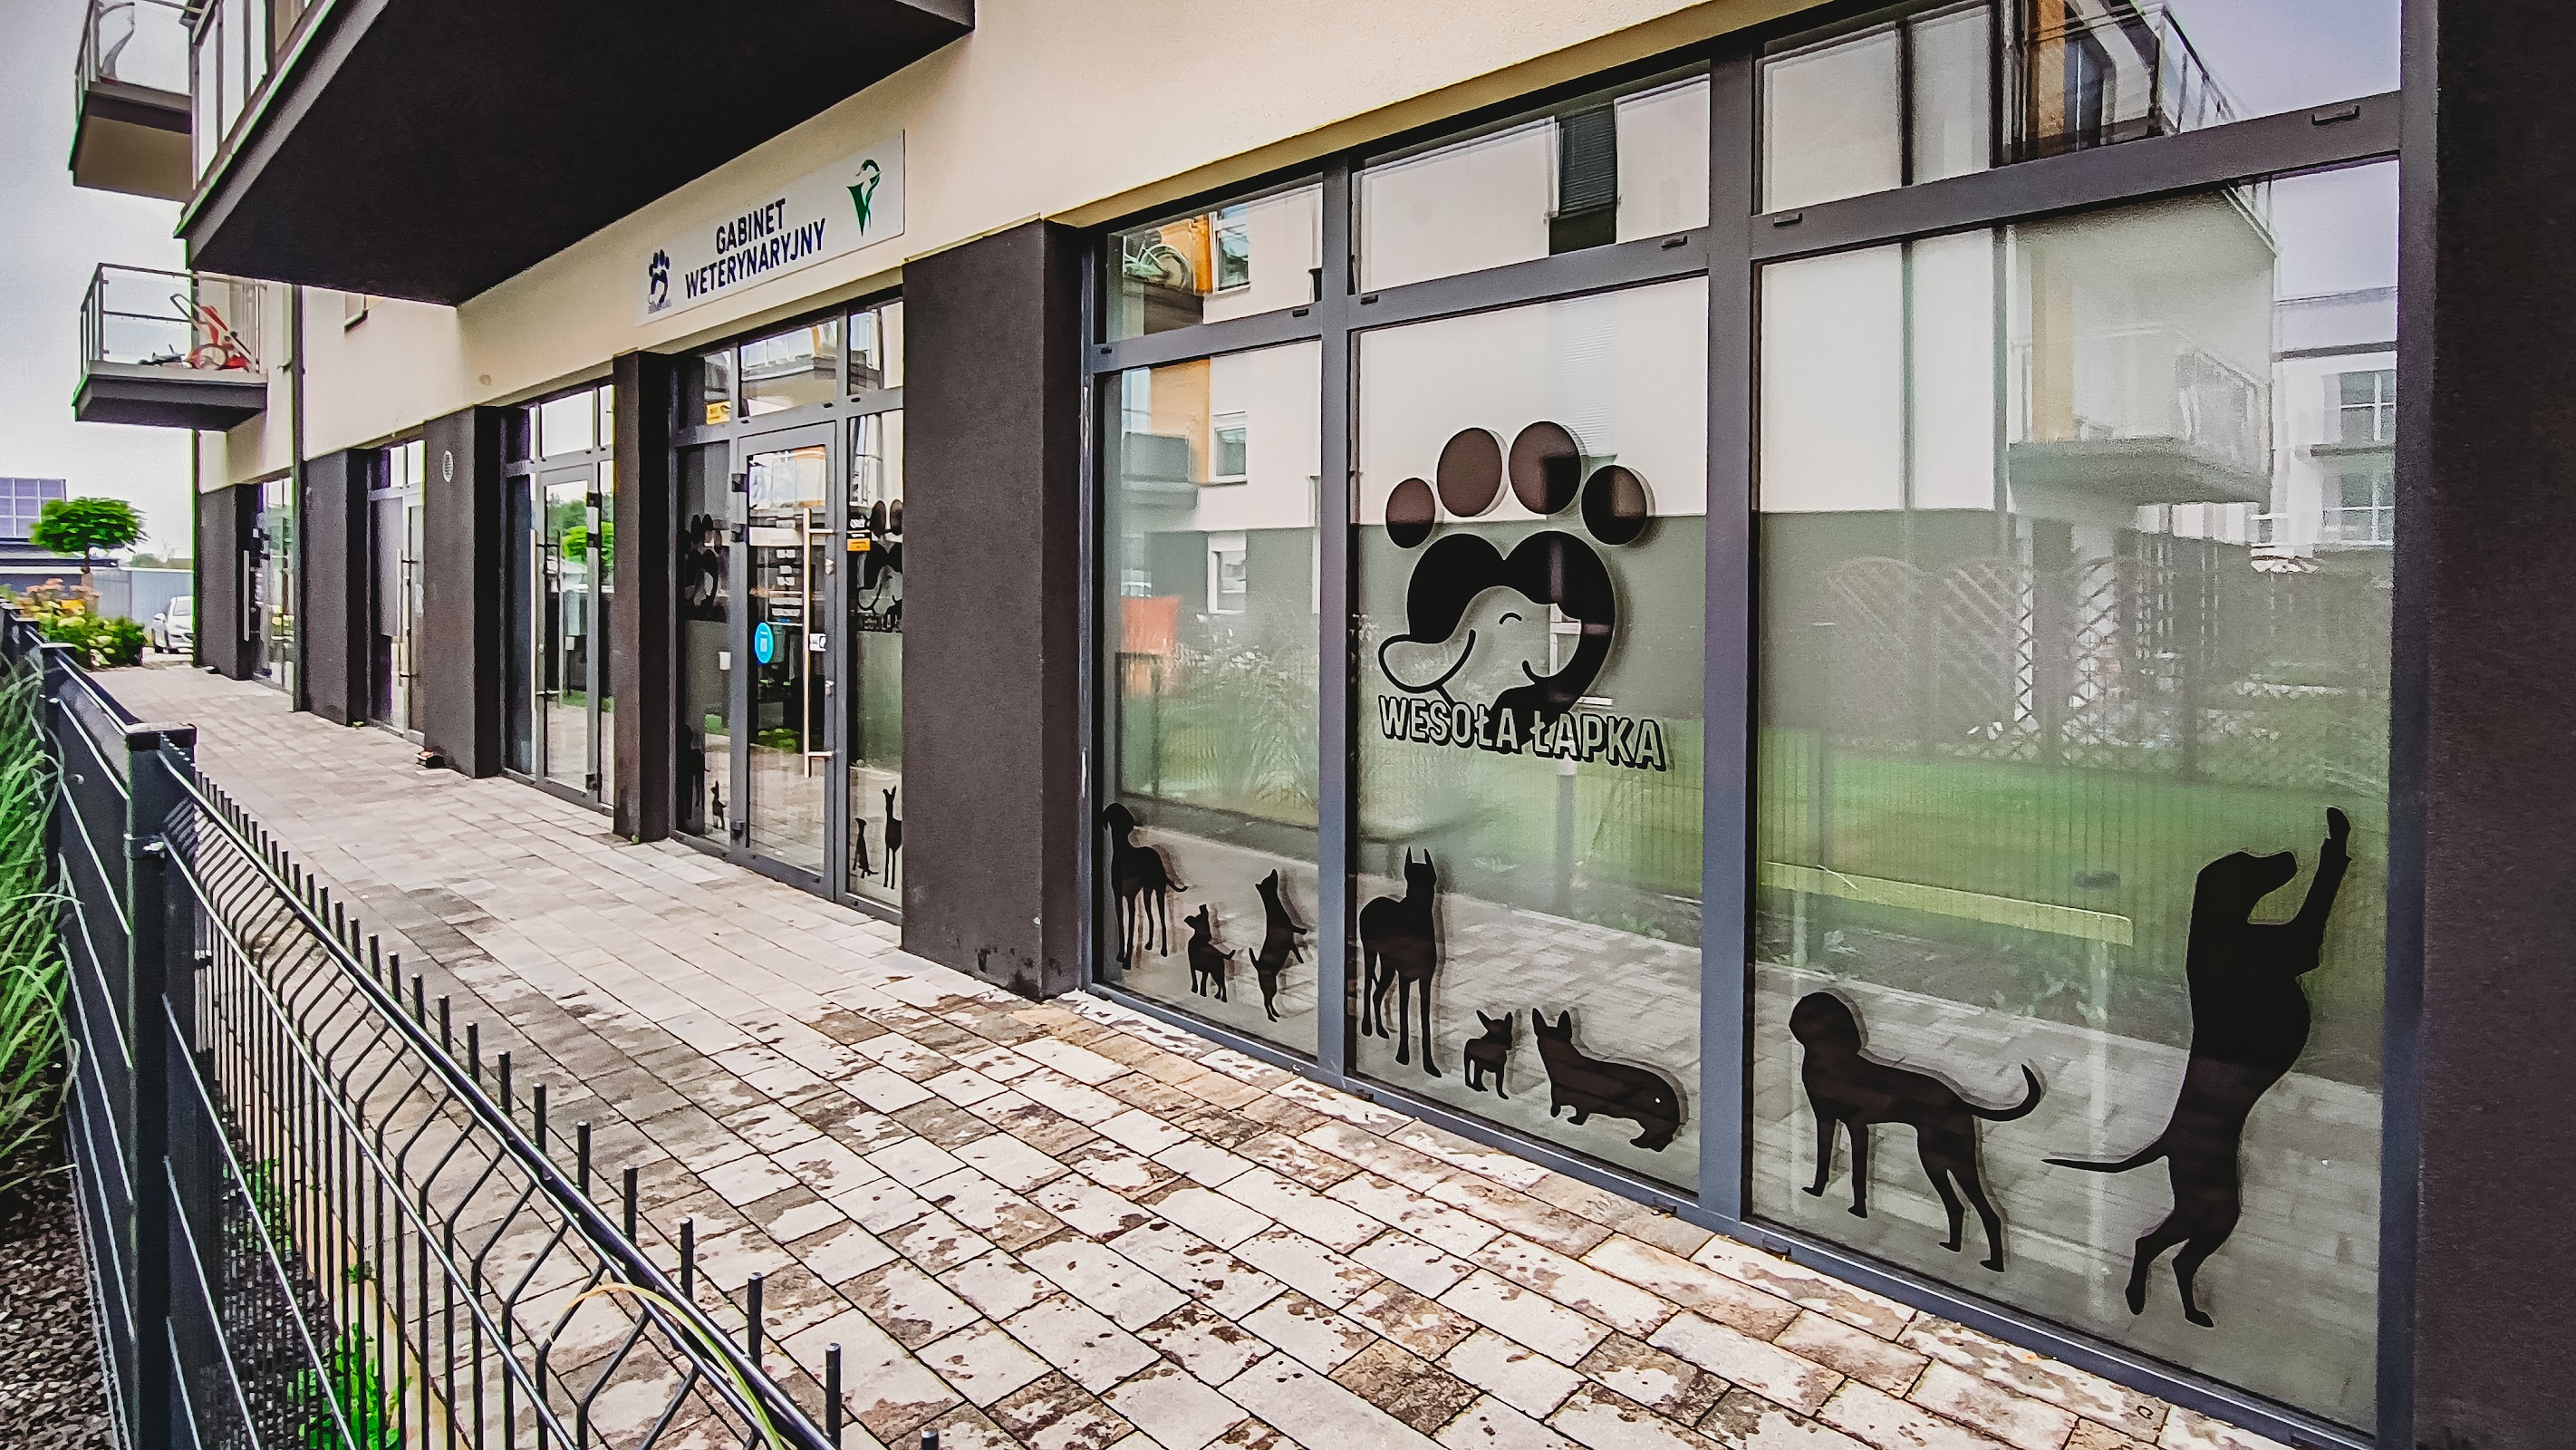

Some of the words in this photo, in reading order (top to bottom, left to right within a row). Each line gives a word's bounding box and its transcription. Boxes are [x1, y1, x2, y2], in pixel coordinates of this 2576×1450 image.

[684, 218, 826, 300] WETERYNARYJNY
[716, 198, 786, 256] GABINET
[1378, 695, 1522, 754] WESOŁA
[1529, 710, 1667, 771] ŁAPKA
